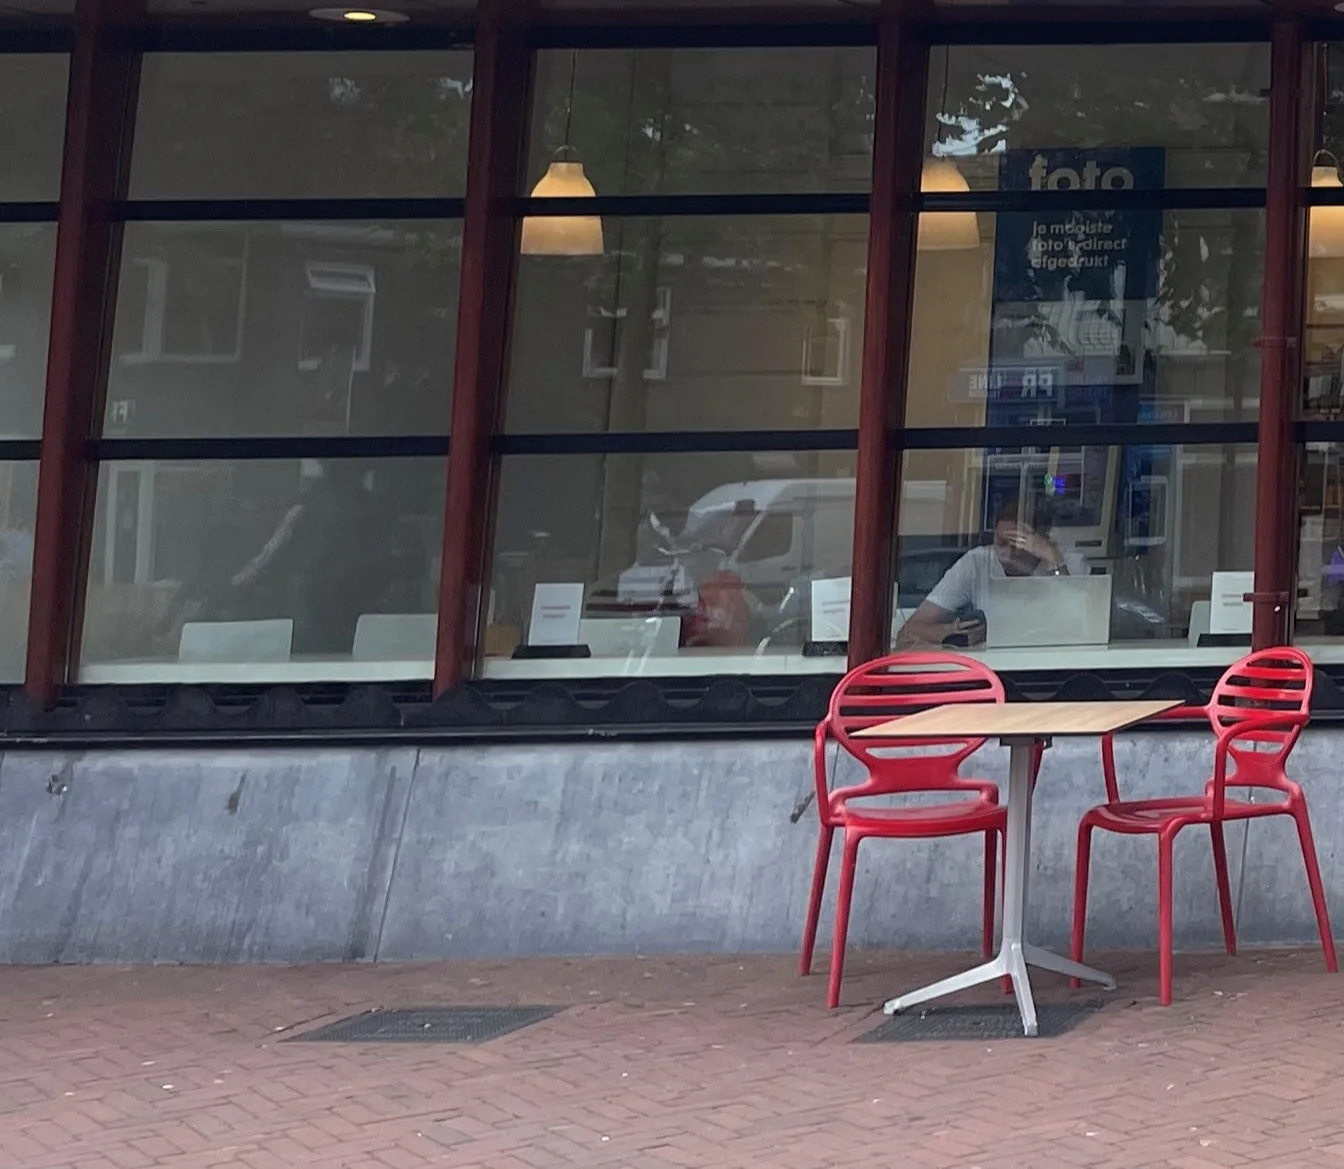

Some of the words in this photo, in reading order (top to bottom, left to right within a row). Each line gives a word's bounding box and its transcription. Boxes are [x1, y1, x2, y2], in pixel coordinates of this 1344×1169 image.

[1028, 154, 1135, 190] foto
[1032, 221, 1047, 237] je
[1050, 220, 1113, 234] mooiste
[1031, 254, 1110, 271] afgedrukt
